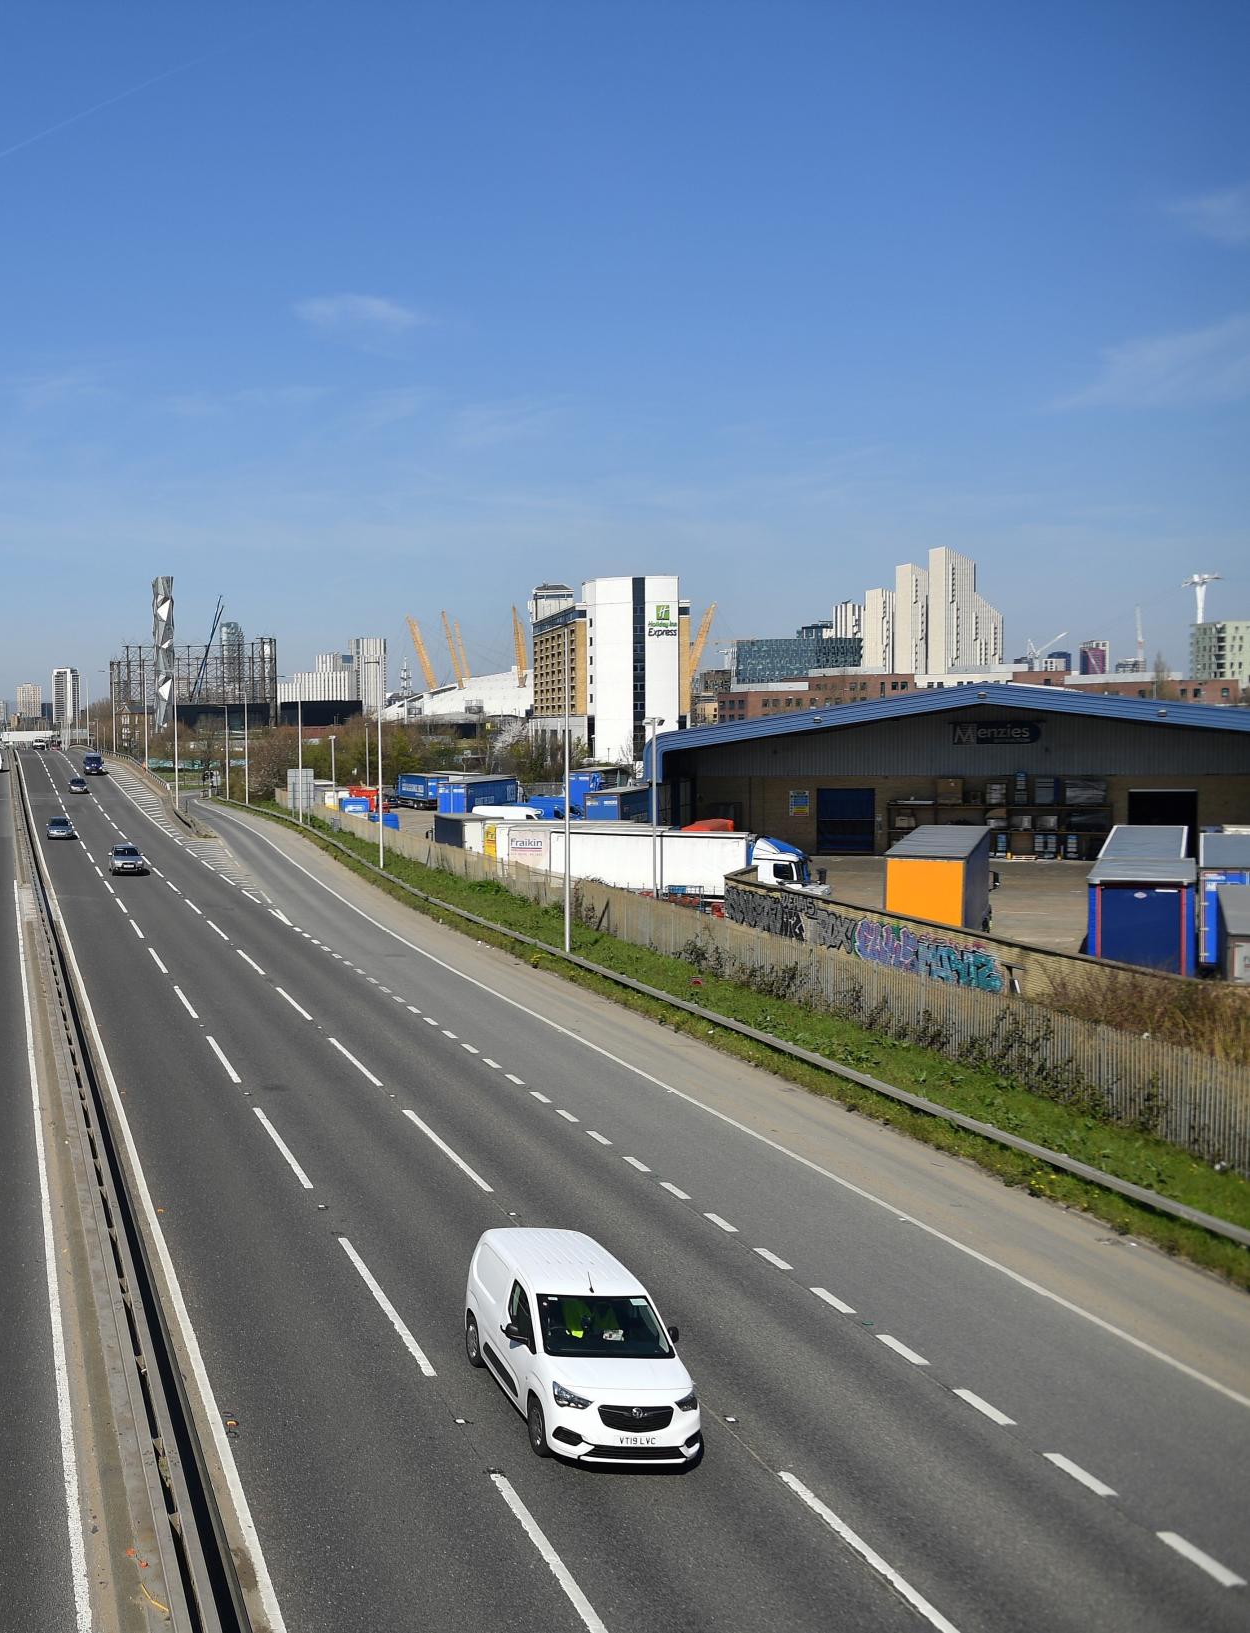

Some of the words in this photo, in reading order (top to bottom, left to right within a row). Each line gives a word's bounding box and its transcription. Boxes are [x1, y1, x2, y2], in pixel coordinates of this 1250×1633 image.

[648, 628, 677, 637] Express
[953, 723, 1030, 743] Menzies
[510, 838, 542, 846] Fraikin
[620, 1436, 638, 1445] VT19
